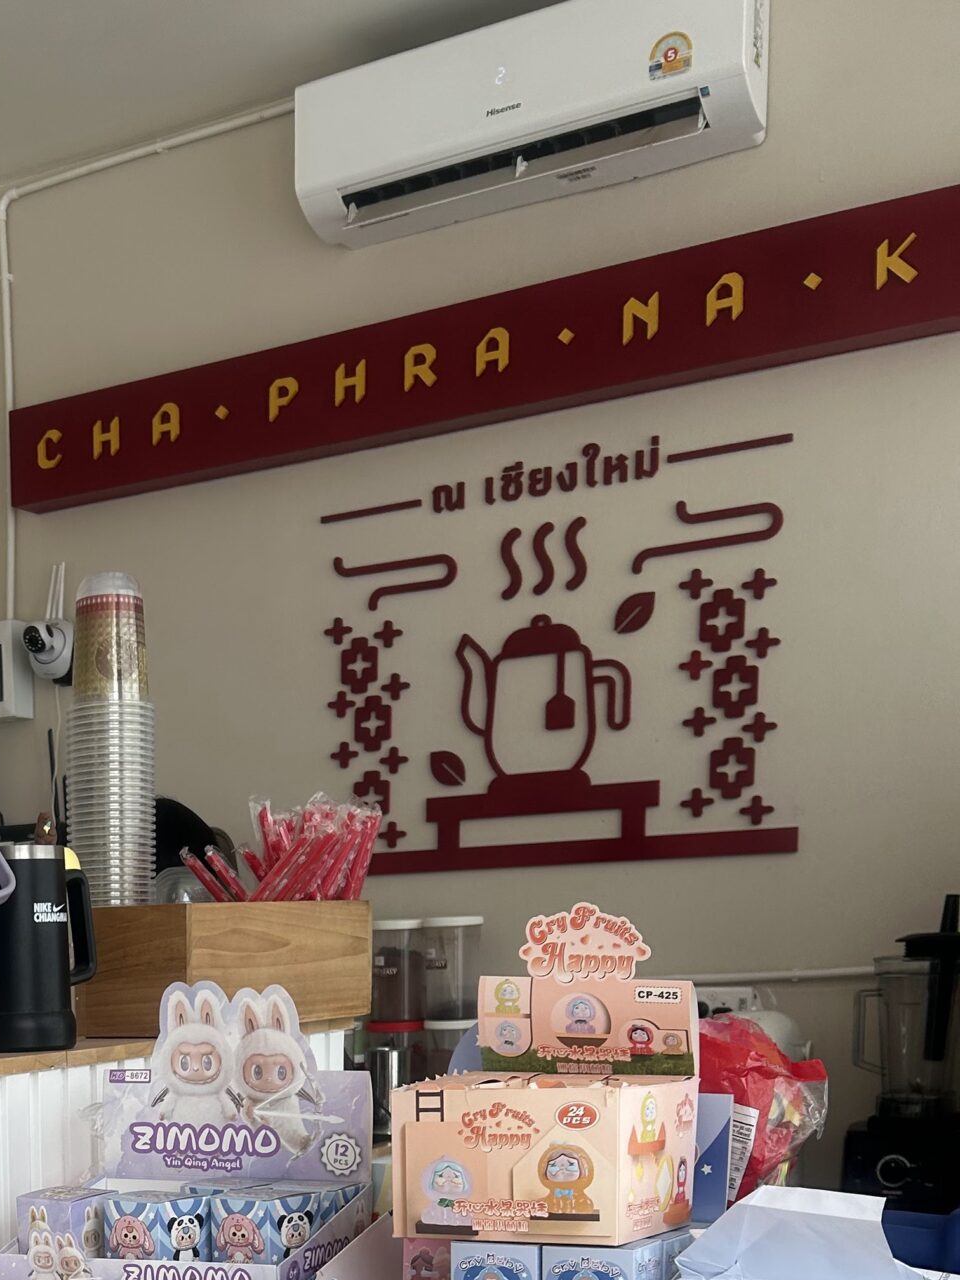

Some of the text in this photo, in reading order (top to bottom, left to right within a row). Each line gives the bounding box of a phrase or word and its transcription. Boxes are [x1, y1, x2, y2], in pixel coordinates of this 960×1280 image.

[486, 102, 522, 117] Hisense
[36, 402, 180, 470] CHA
[268, 326, 511, 423] PHRA
[622, 271, 745, 346] NA
[432, 434, 660, 514] ณ เชียงใหม่
[33, 903, 52, 912] NIKE
[529, 906, 640, 946] Cry Fruits
[531, 941, 635, 984] Happy
[637, 990, 679, 1001] CP-425
[110, 1070, 149, 1081] KO-8672
[461, 1102, 535, 1129] Cry Fruits
[568, 1106, 584, 1117] 24
[131, 1122, 280, 1156] ZIMOMO
[464, 1126, 533, 1152] Happy
[334, 1143, 349, 1157] 12
[164, 1156, 241, 1171] Yin Qing Angel
[459, 1253, 525, 1273] Cry Baby
[551, 1260, 577, 1276] Cry
[579, 1257, 621, 1278] Baby
